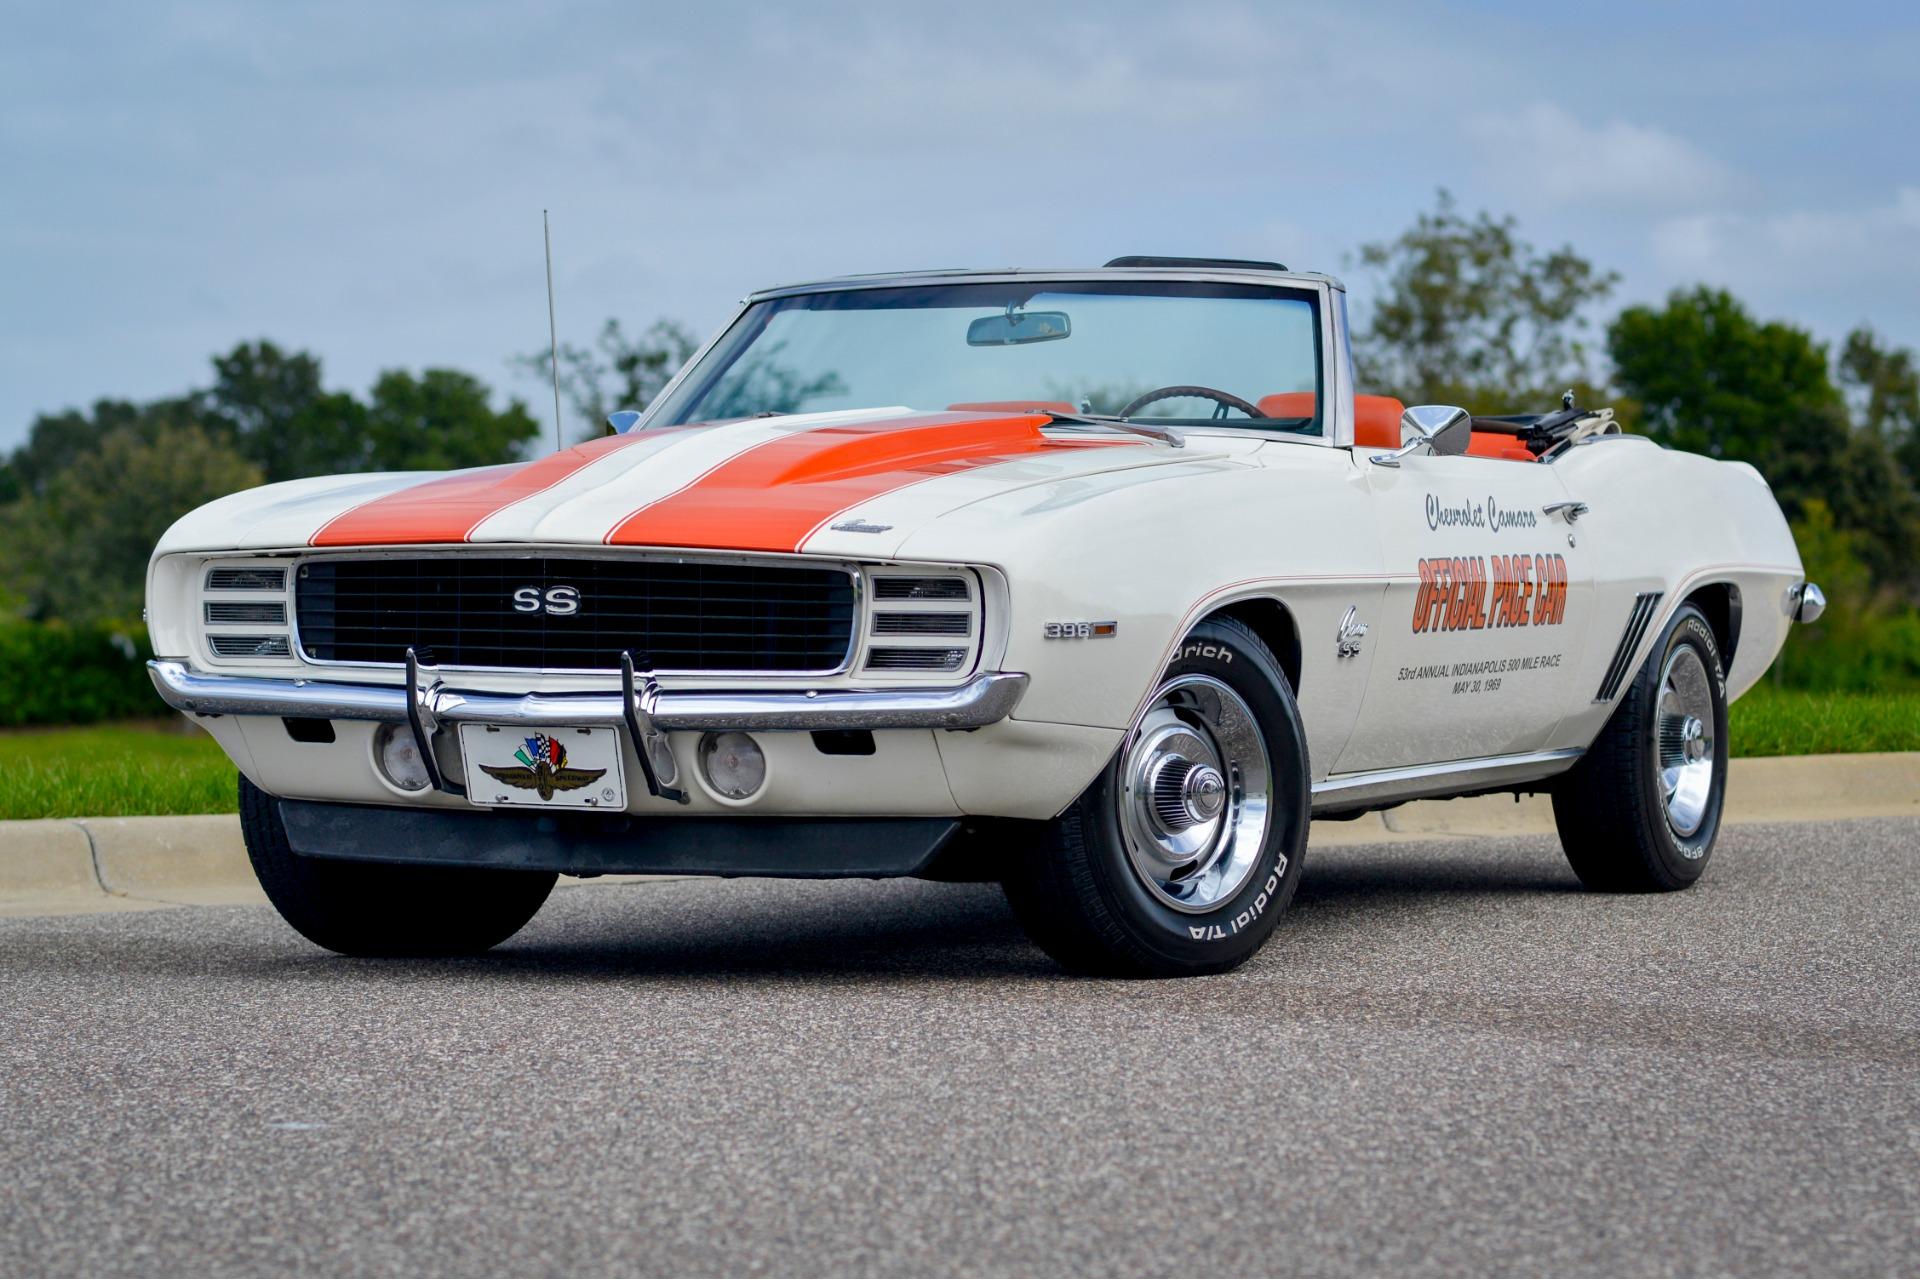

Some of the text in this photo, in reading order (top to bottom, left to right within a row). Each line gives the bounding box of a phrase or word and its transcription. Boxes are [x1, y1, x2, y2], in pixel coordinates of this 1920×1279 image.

[1426, 494, 1537, 533] Chevrolet Camaro
[513, 585, 581, 615] SS
[1412, 556, 1487, 634] OFFICIAL
[1487, 554, 1533, 629] PACE
[1533, 553, 1568, 627] CAR
[1044, 622, 1090, 639] 396
[1687, 619, 1717, 657] Radial
[1397, 653, 1562, 681] 53rd ANNUAL INDIANAPOLIS 500 MILE RACE
[1452, 678, 1502, 694] MAY 30, 1969
[1188, 851, 1288, 941] Radial T/A
